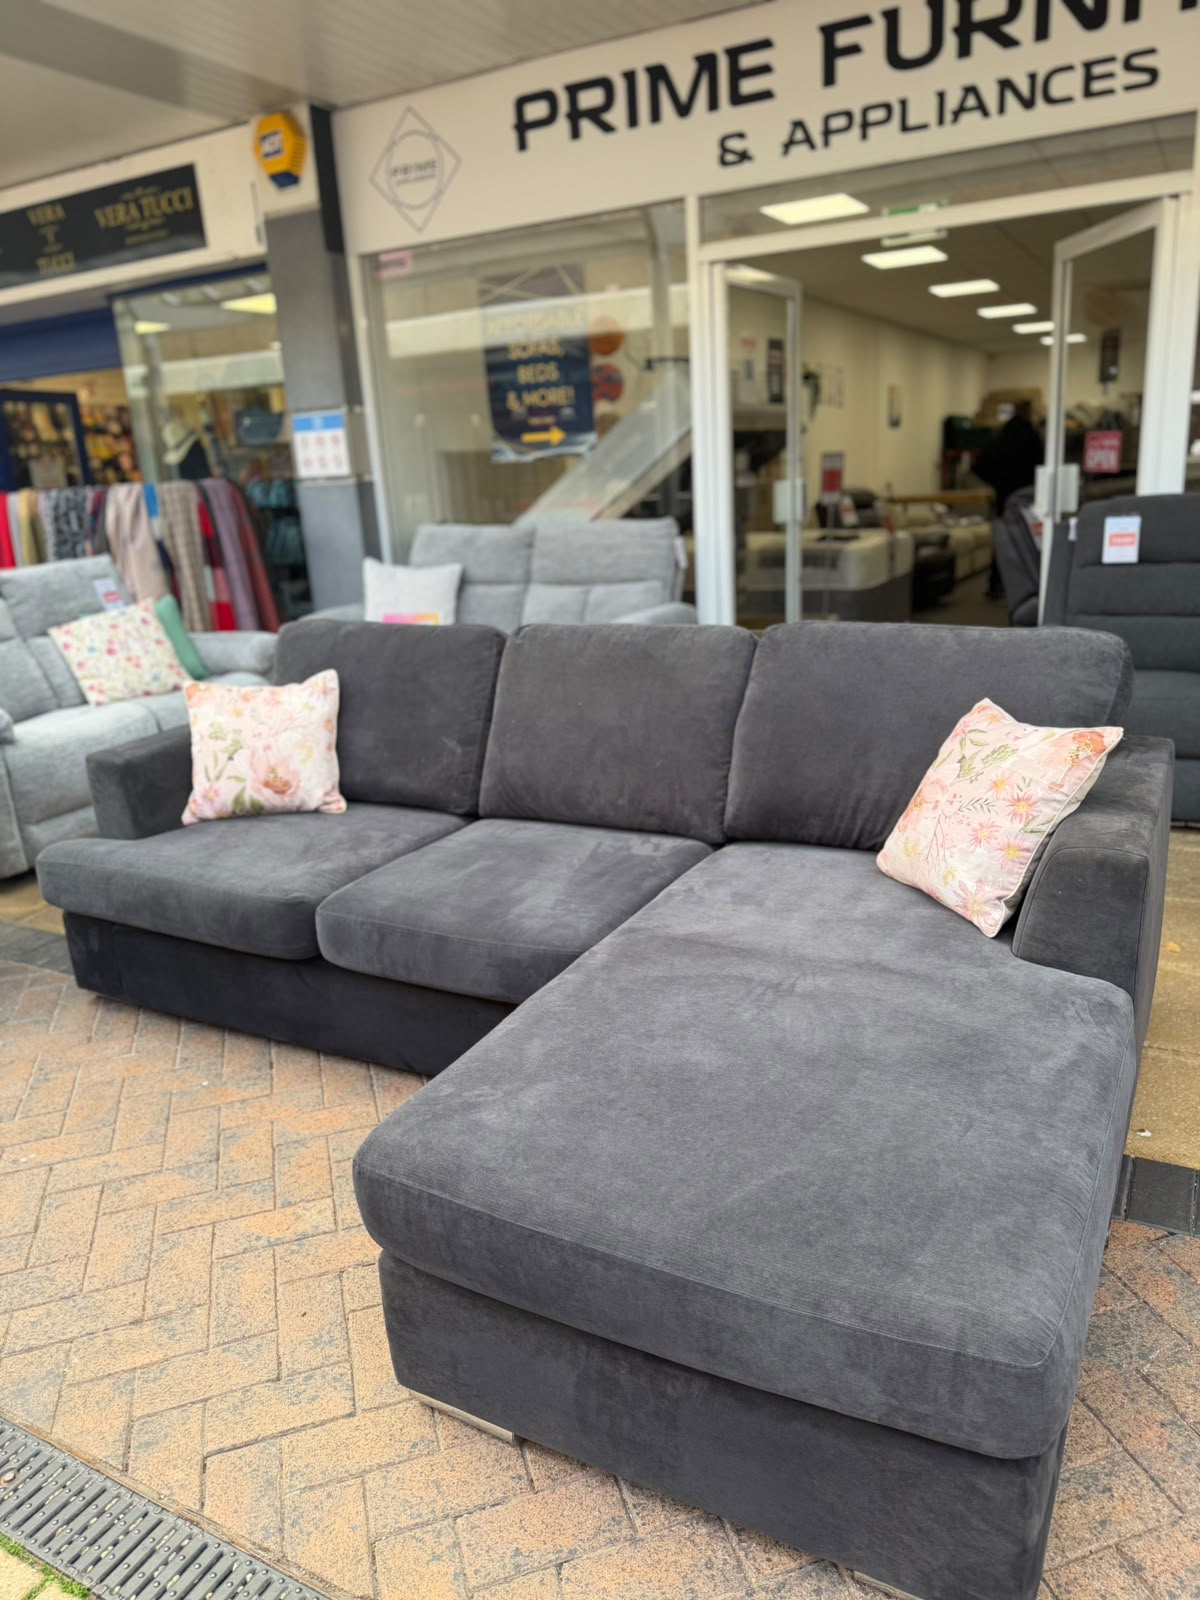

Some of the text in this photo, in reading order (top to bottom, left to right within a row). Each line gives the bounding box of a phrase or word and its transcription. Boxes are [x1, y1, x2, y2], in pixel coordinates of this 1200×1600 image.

[514, 0, 1200, 152] PRIME FURN
[719, 48, 1159, 167] & APPLIANCES
